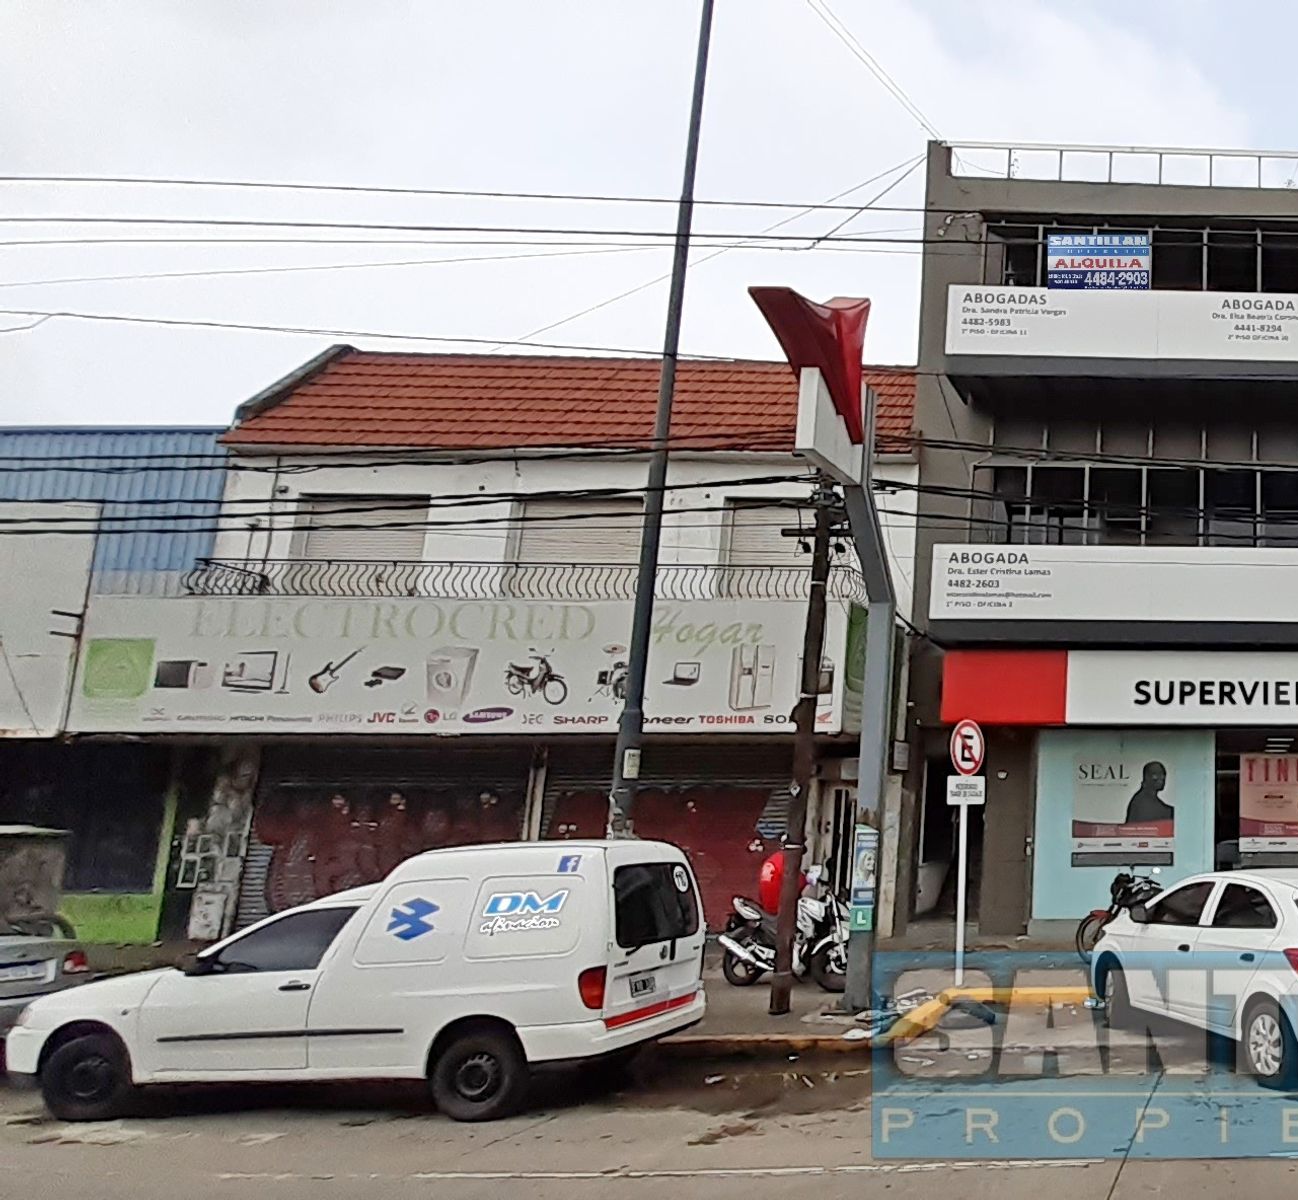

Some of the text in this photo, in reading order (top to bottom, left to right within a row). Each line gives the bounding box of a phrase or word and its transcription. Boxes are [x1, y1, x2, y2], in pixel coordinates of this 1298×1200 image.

[1049, 236, 1147, 246] SANTILLAN
[1054, 258, 1143, 269] ALQUILA
[1084, 271, 1148, 286] 4484-2903
[963, 293, 1047, 305] ABOGADAS
[1222, 299, 1295, 311] ABOGADA
[948, 552, 1029, 564] ABOGADA
[189, 601, 596, 640] ELECTROCRED
[653, 606, 762, 657] Hogar
[368, 712, 397, 723] JVC
[443, 712, 458, 721] LG
[553, 715, 609, 725] SHARP
[699, 715, 755, 724] TOSHIBA
[960, 734, 974, 762] E
[1079, 764, 1129, 779] SEAL
[483, 890, 568, 916] DM
